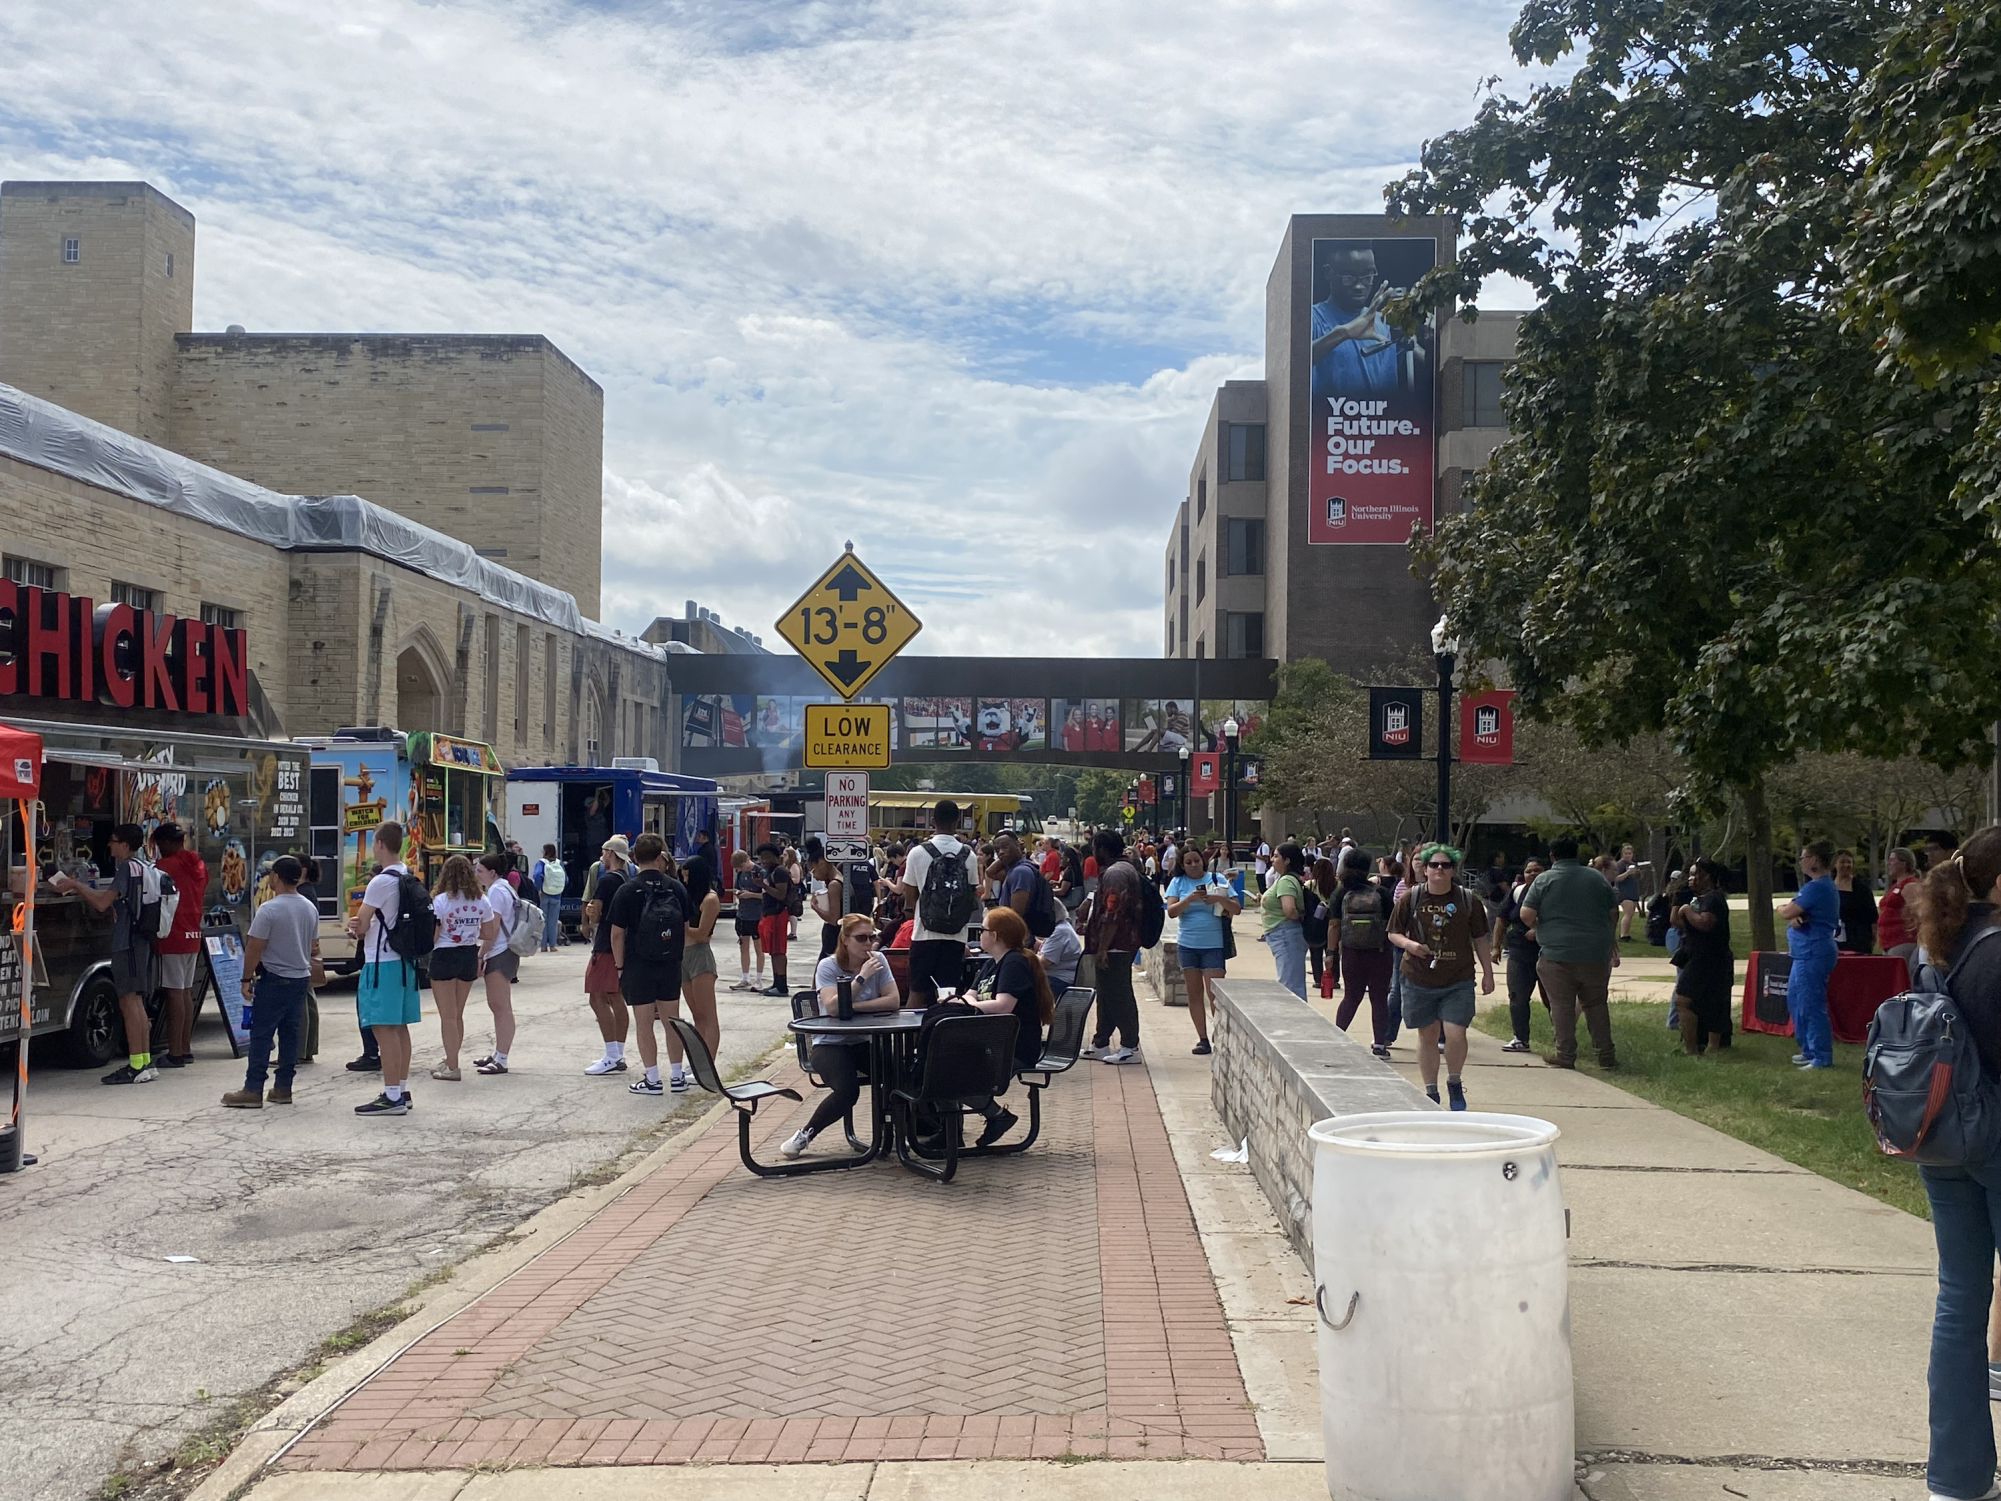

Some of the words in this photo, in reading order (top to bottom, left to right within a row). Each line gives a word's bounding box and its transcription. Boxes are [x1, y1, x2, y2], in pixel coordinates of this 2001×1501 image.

[1327, 397, 1388, 416] Your
[1327, 416, 1420, 435] Future.
[1327, 436, 1375, 455] Our
[1327, 456, 1409, 474] Focus.
[1351, 513, 1393, 521] University
[824, 717, 871, 737] LOW
[813, 743, 882, 756] CLEARANCE
[278, 771, 300, 790] BEST
[839, 779, 855, 791] NO
[828, 795, 865, 807] PARKING
[838, 810, 856, 818] ANY
[837, 821, 857, 829] TIME
